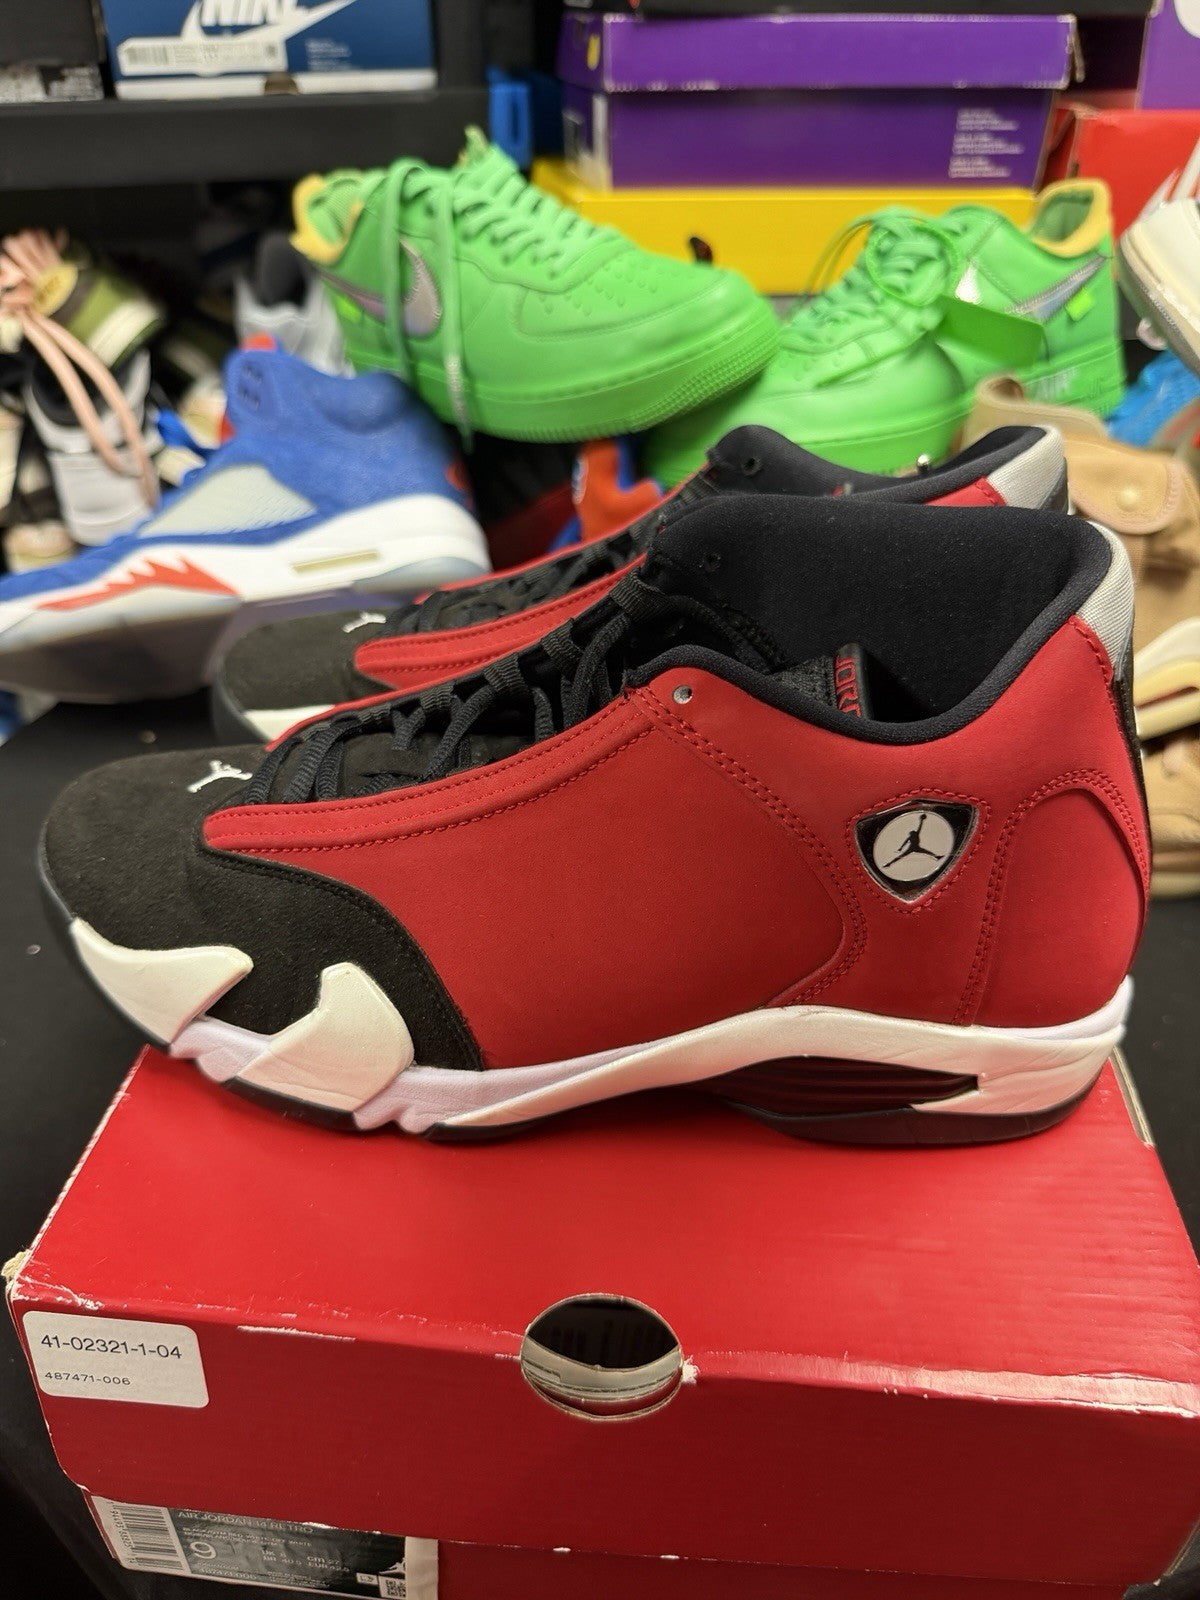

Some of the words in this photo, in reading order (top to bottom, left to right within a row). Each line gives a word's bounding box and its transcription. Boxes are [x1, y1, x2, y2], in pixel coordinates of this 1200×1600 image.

[41, 1334, 182, 1359] 41-02321-1-04
[45, 1371, 131, 1386] 487471-006
[178, 1511, 199, 1519] AIR
[200, 1513, 252, 1525] JORDAN
[270, 1521, 314, 1534] RETRO
[189, 1541, 217, 1560] 9
